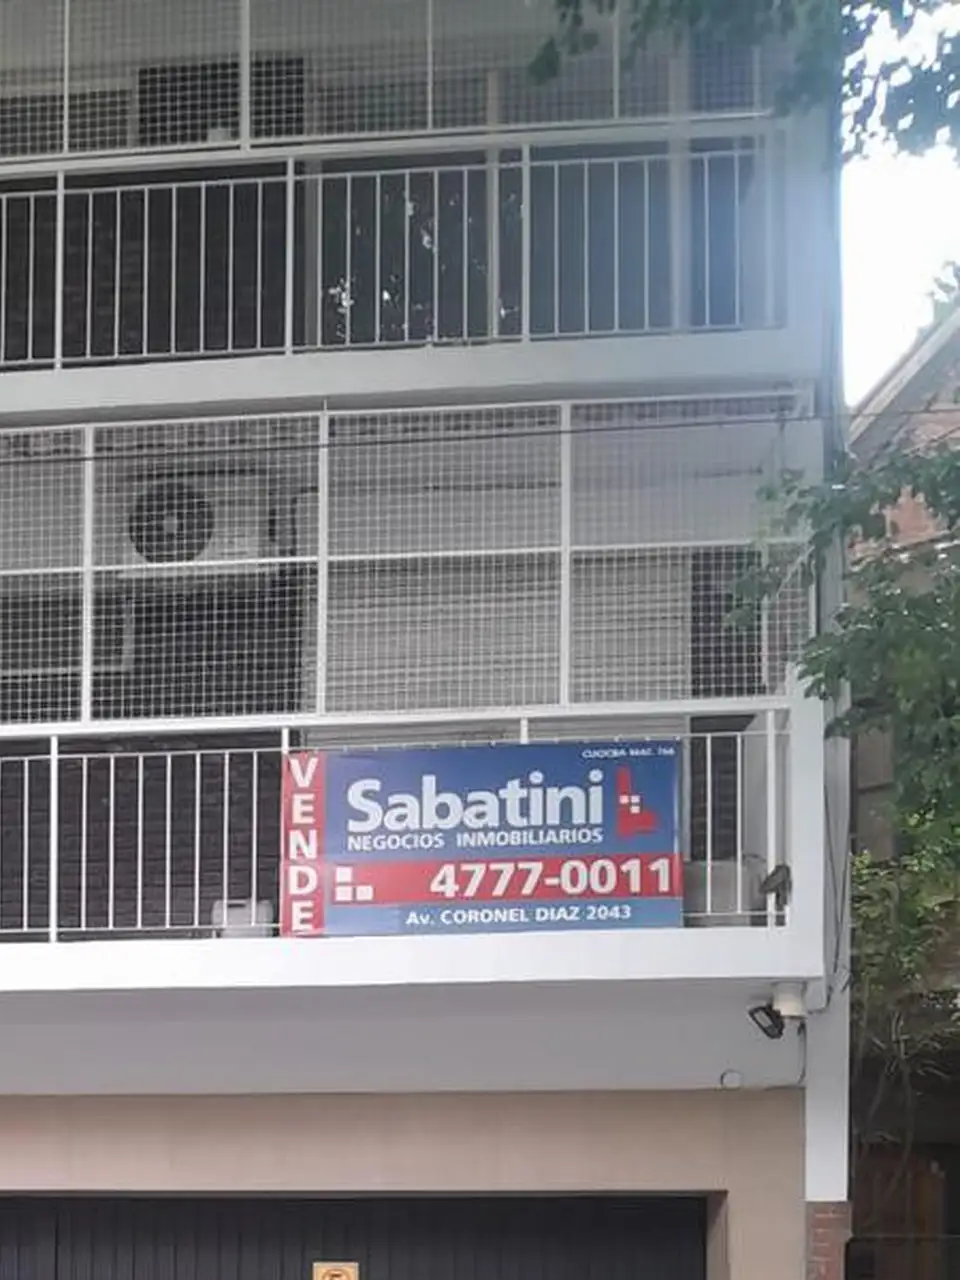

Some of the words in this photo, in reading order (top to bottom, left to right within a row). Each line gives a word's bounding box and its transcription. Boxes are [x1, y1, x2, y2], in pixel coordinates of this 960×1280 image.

[347, 769, 604, 833] Sabatini
[289, 757, 319, 932] VENDE
[347, 833, 445, 851] NEGOCIOS
[456, 828, 604, 848] INMOBILIARIOS
[430, 858, 671, 899] 4777-0011
[405, 911, 435, 925] Av.
[440, 907, 529, 925] CORONEL
[535, 906, 581, 922] DIAZ
[586, 904, 632, 920] 2043
